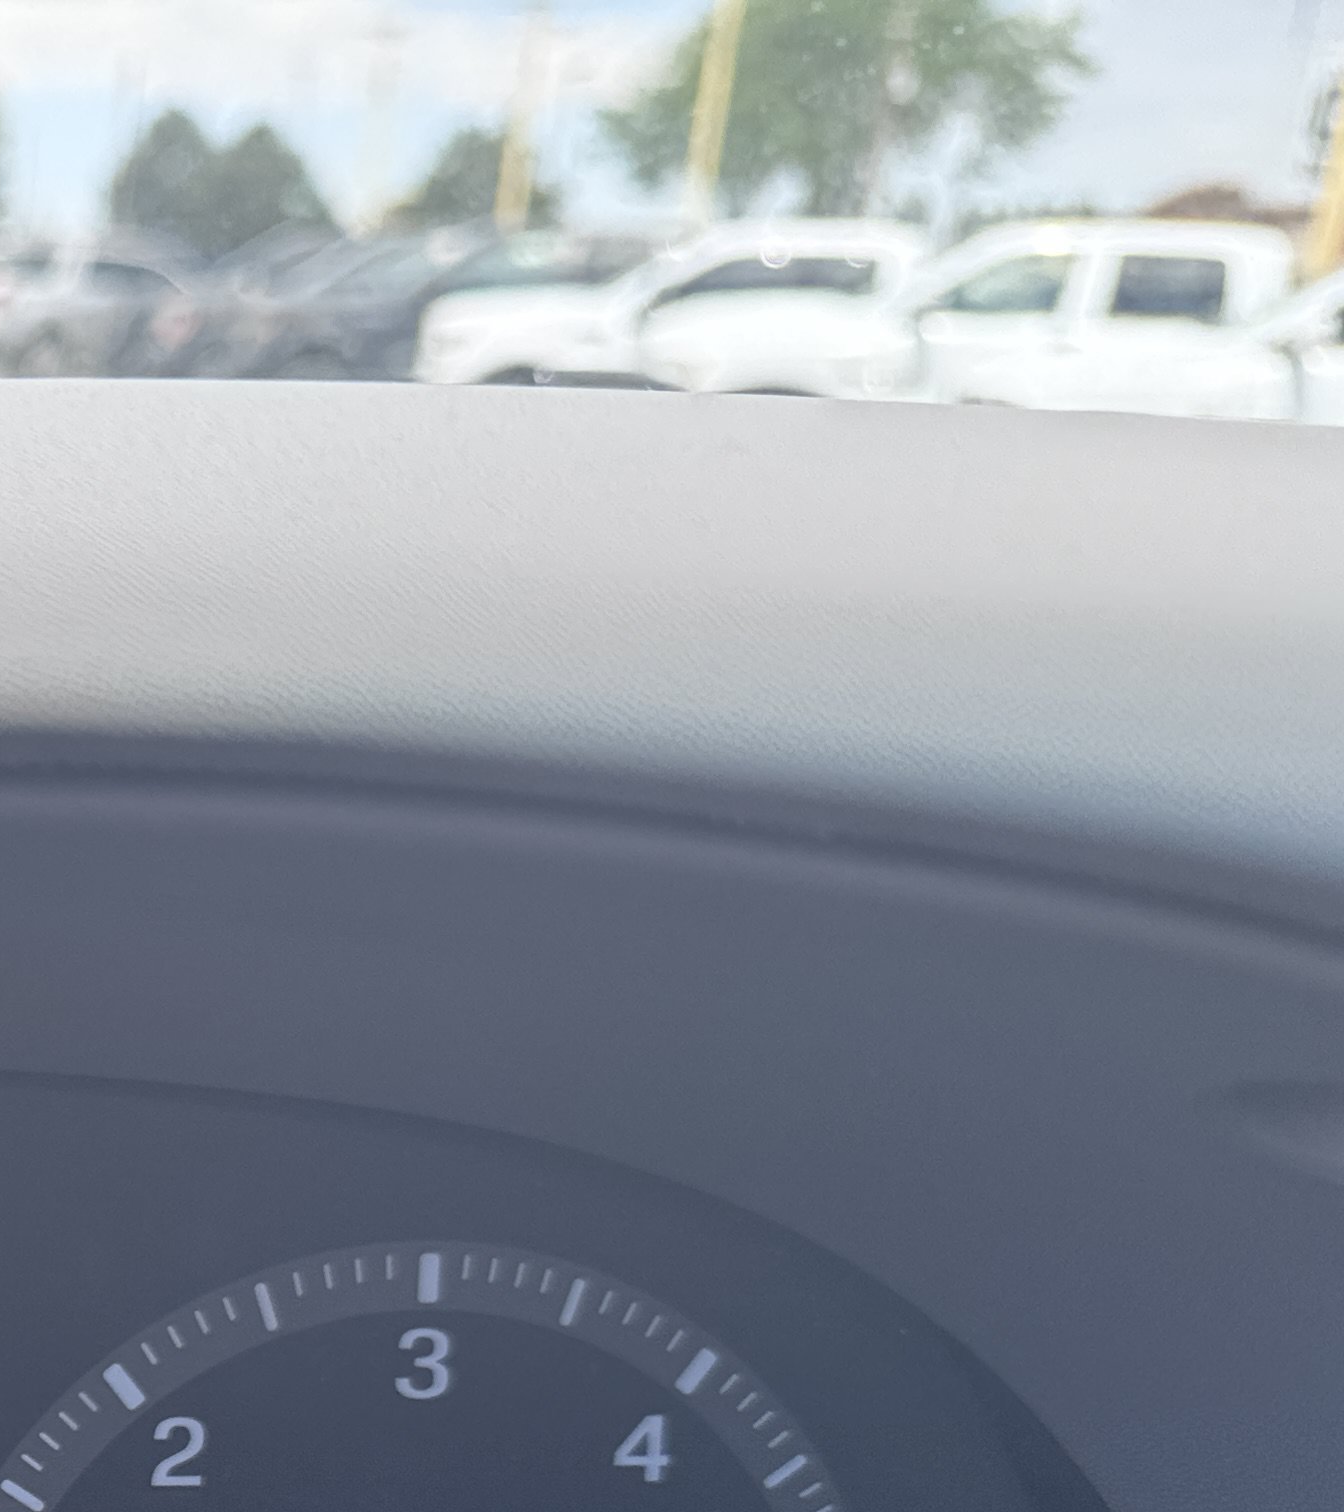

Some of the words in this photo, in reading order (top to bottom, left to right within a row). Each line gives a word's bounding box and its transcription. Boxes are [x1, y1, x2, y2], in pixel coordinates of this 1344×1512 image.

[396, 1327, 450, 1399] 3
[151, 1416, 205, 1487] 2
[615, 1414, 670, 1482] 4
